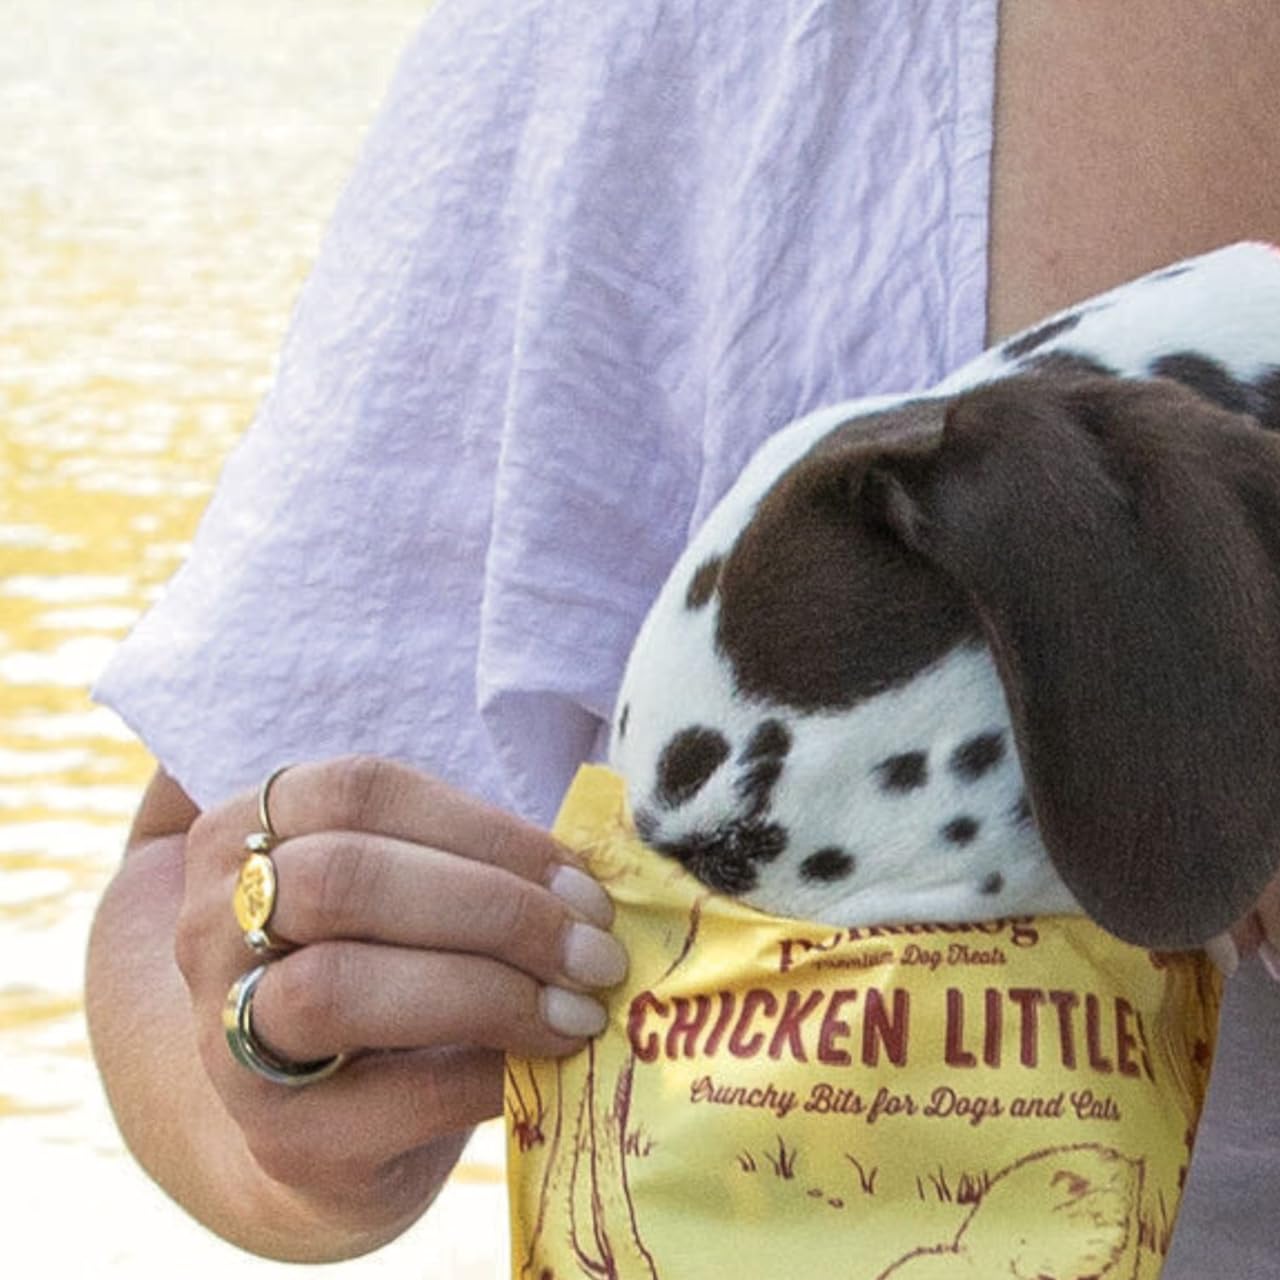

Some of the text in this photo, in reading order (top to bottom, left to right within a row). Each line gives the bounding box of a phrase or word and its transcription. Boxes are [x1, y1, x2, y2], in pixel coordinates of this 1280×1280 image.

[900, 944, 941, 972] Dog
[947, 944, 1007, 966] Treats
[627, 988, 910, 1067] CHICKEN
[690, 1076, 1121, 1126] Crunchy Bits for Dogs and Cats
